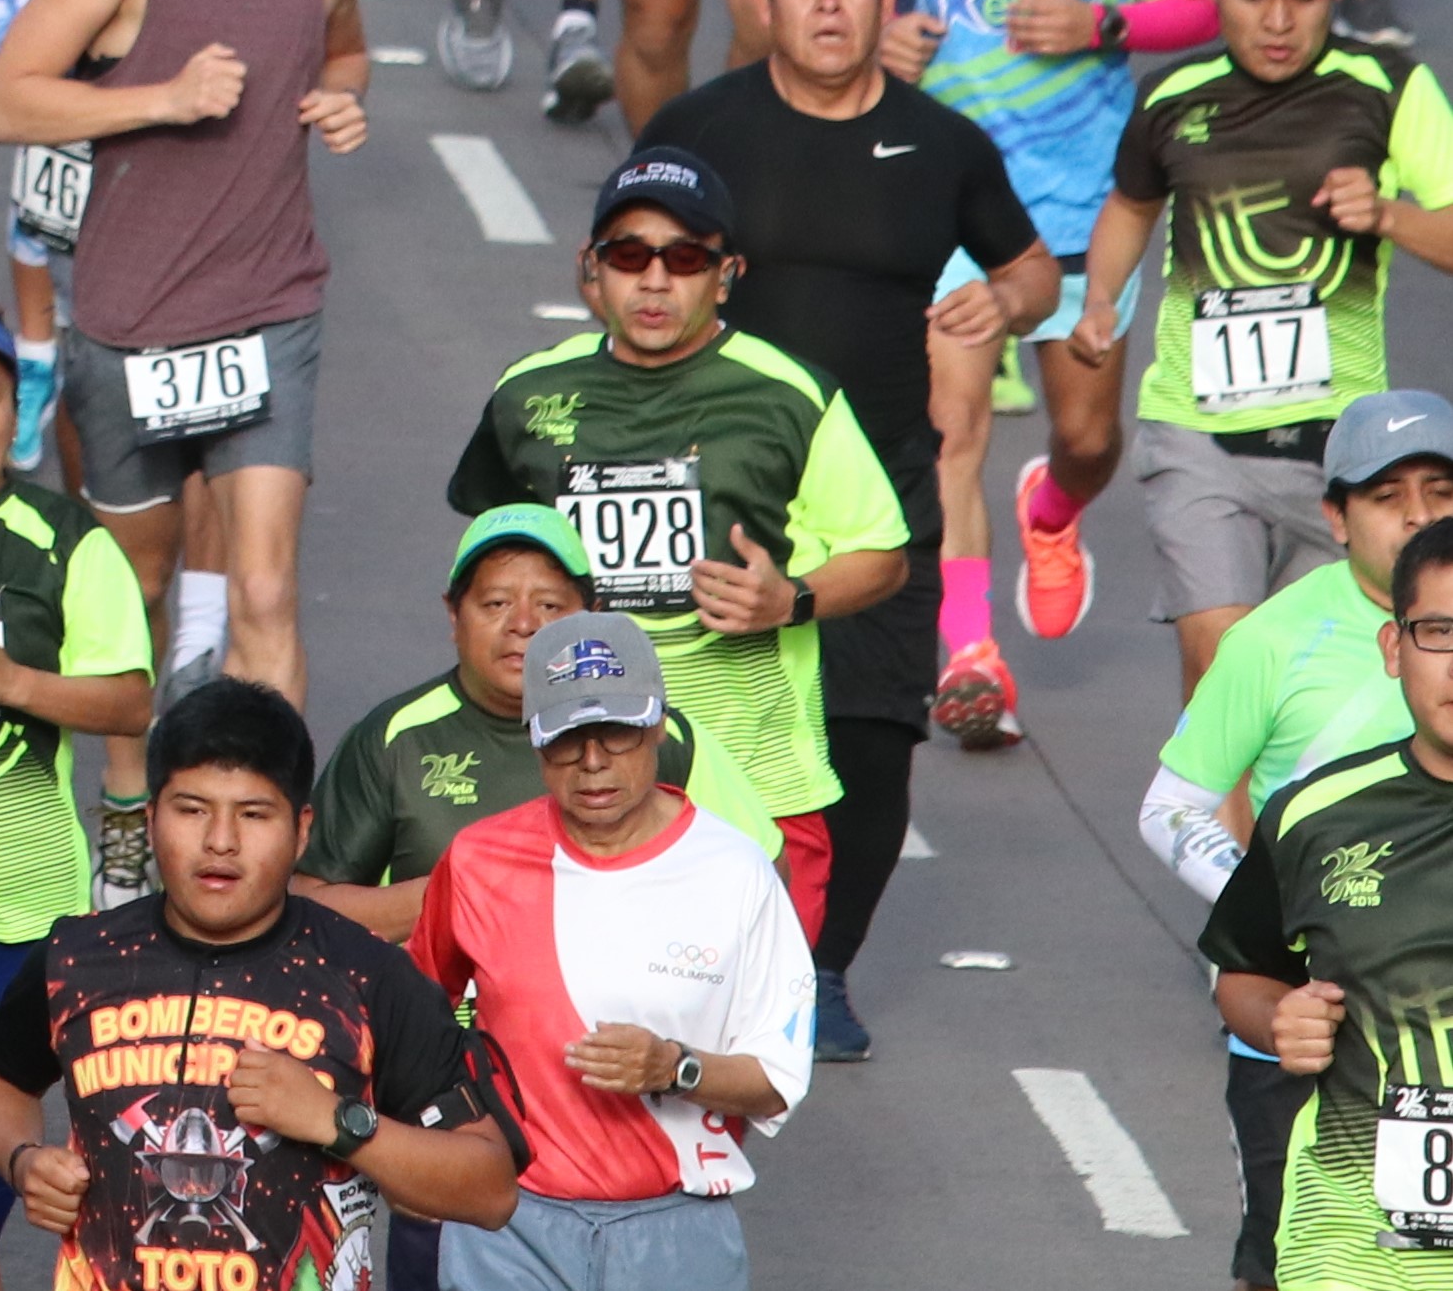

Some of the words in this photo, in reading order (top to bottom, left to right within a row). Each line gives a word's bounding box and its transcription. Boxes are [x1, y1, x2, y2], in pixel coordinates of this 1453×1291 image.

[34, 161, 81, 216] 46
[1214, 317, 1303, 385] 117
[150, 344, 246, 410] 376
[608, 598, 655, 609] MEDALLA
[445, 780, 474, 795] Xela
[1344, 878, 1379, 897] Xela
[1348, 895, 1382, 908] 2019
[648, 961, 669, 975] DIA
[671, 966, 725, 986] OLIMPICO
[90, 995, 326, 1062] BOMBEROS
[134, 1246, 259, 1291] TOTO
